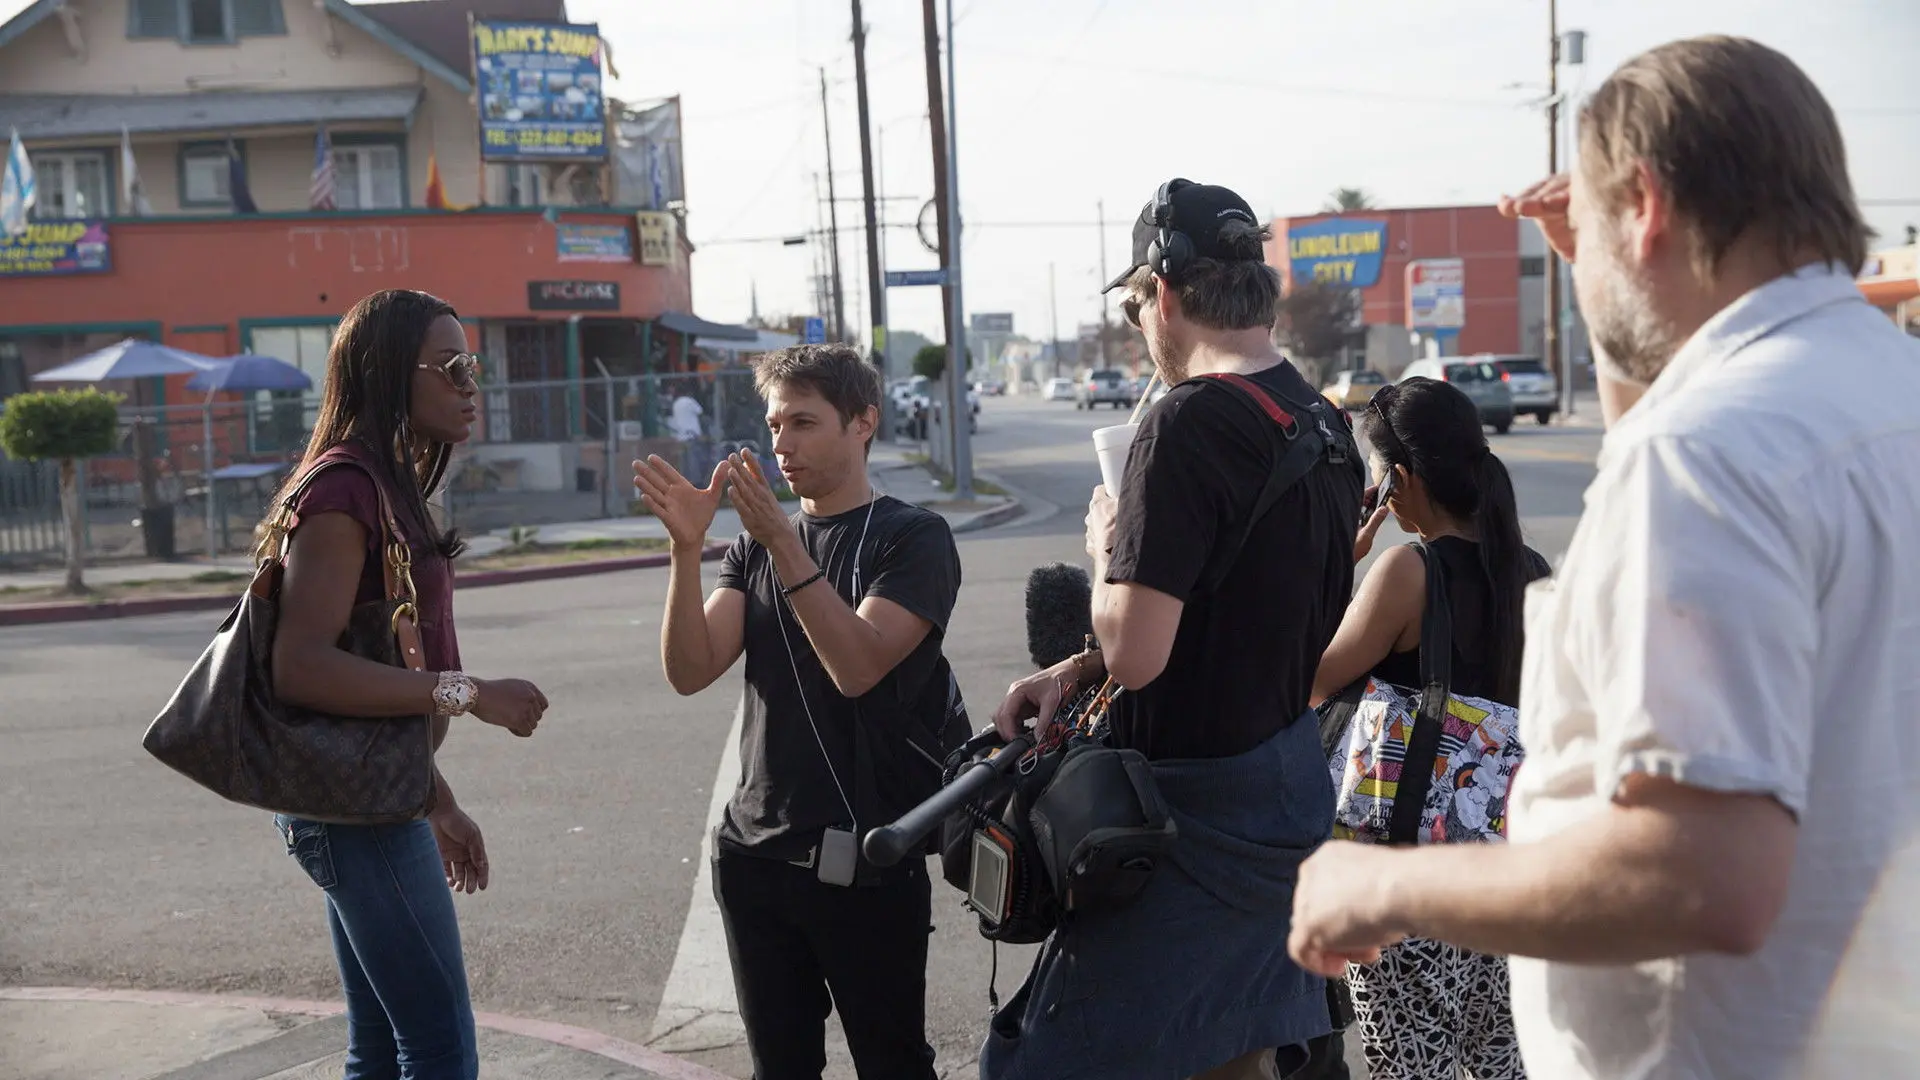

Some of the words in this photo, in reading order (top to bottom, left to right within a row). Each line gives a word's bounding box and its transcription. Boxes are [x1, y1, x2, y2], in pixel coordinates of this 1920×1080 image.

[547, 29, 599, 57] JUMP
[19, 222, 86, 244] JUMP
[1290, 230, 1380, 258] LINOLEUM
[1312, 261, 1355, 285] CITY
